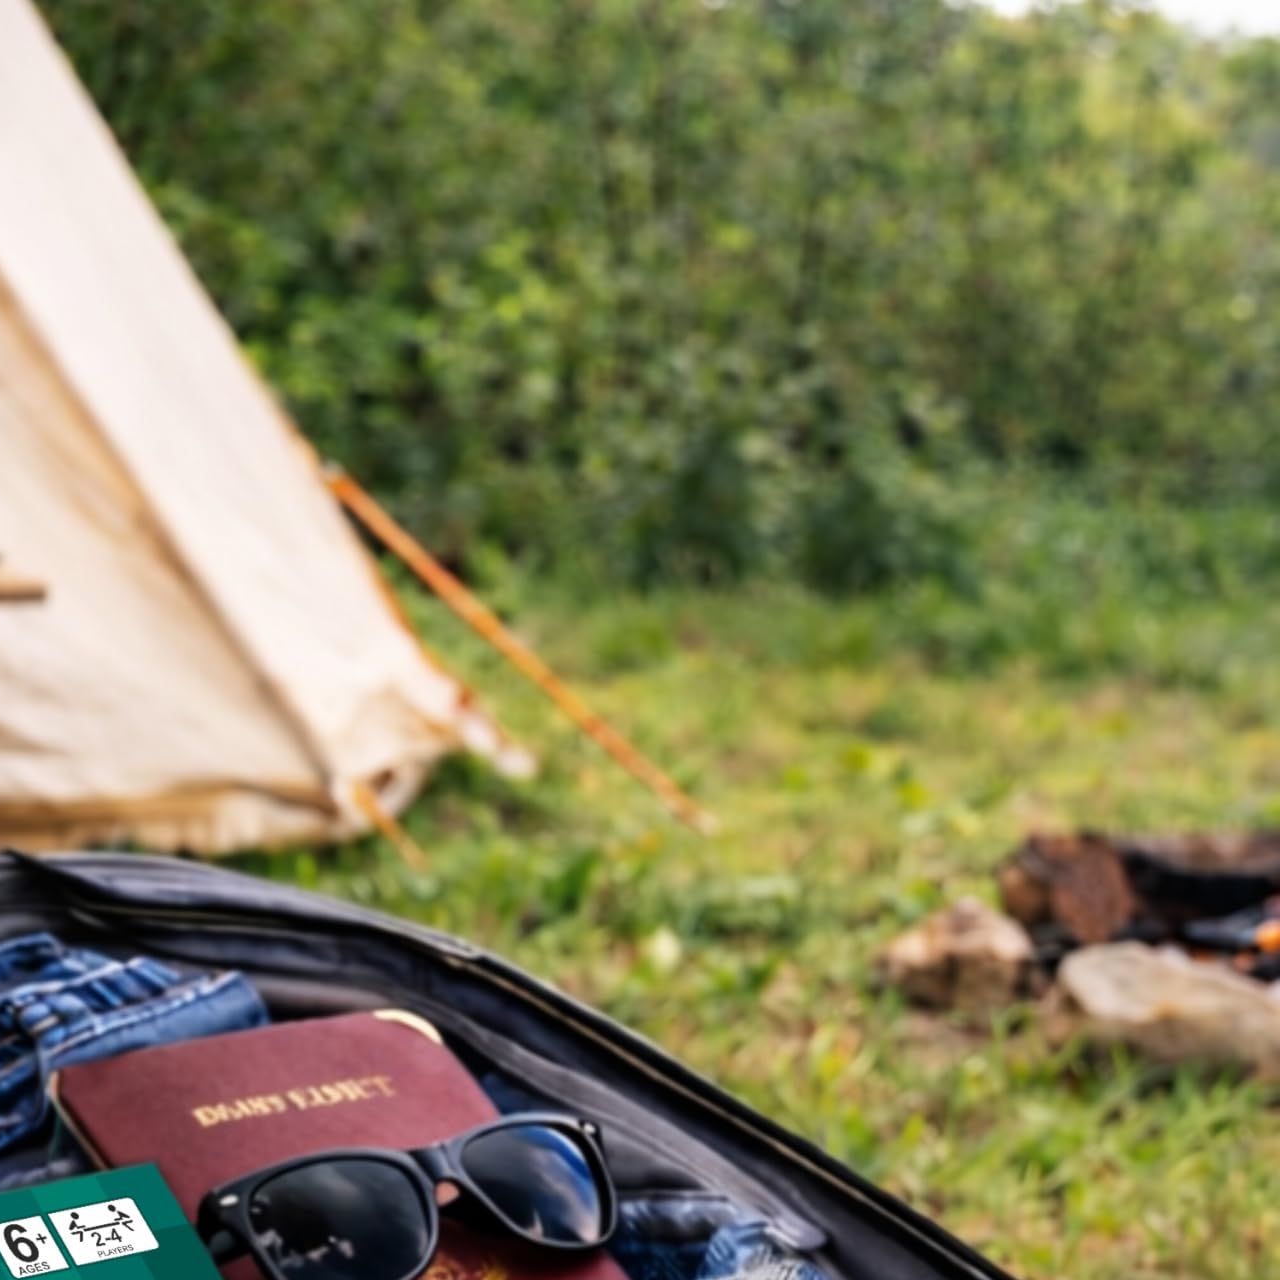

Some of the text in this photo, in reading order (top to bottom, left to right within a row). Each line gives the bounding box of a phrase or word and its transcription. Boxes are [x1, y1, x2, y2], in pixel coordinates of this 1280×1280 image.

[3, 1224, 48, 1264] 6+
[94, 1228, 124, 1248] 2-4
[96, 1244, 136, 1259] PLAYERS
[18, 1261, 51, 1277] AGES
